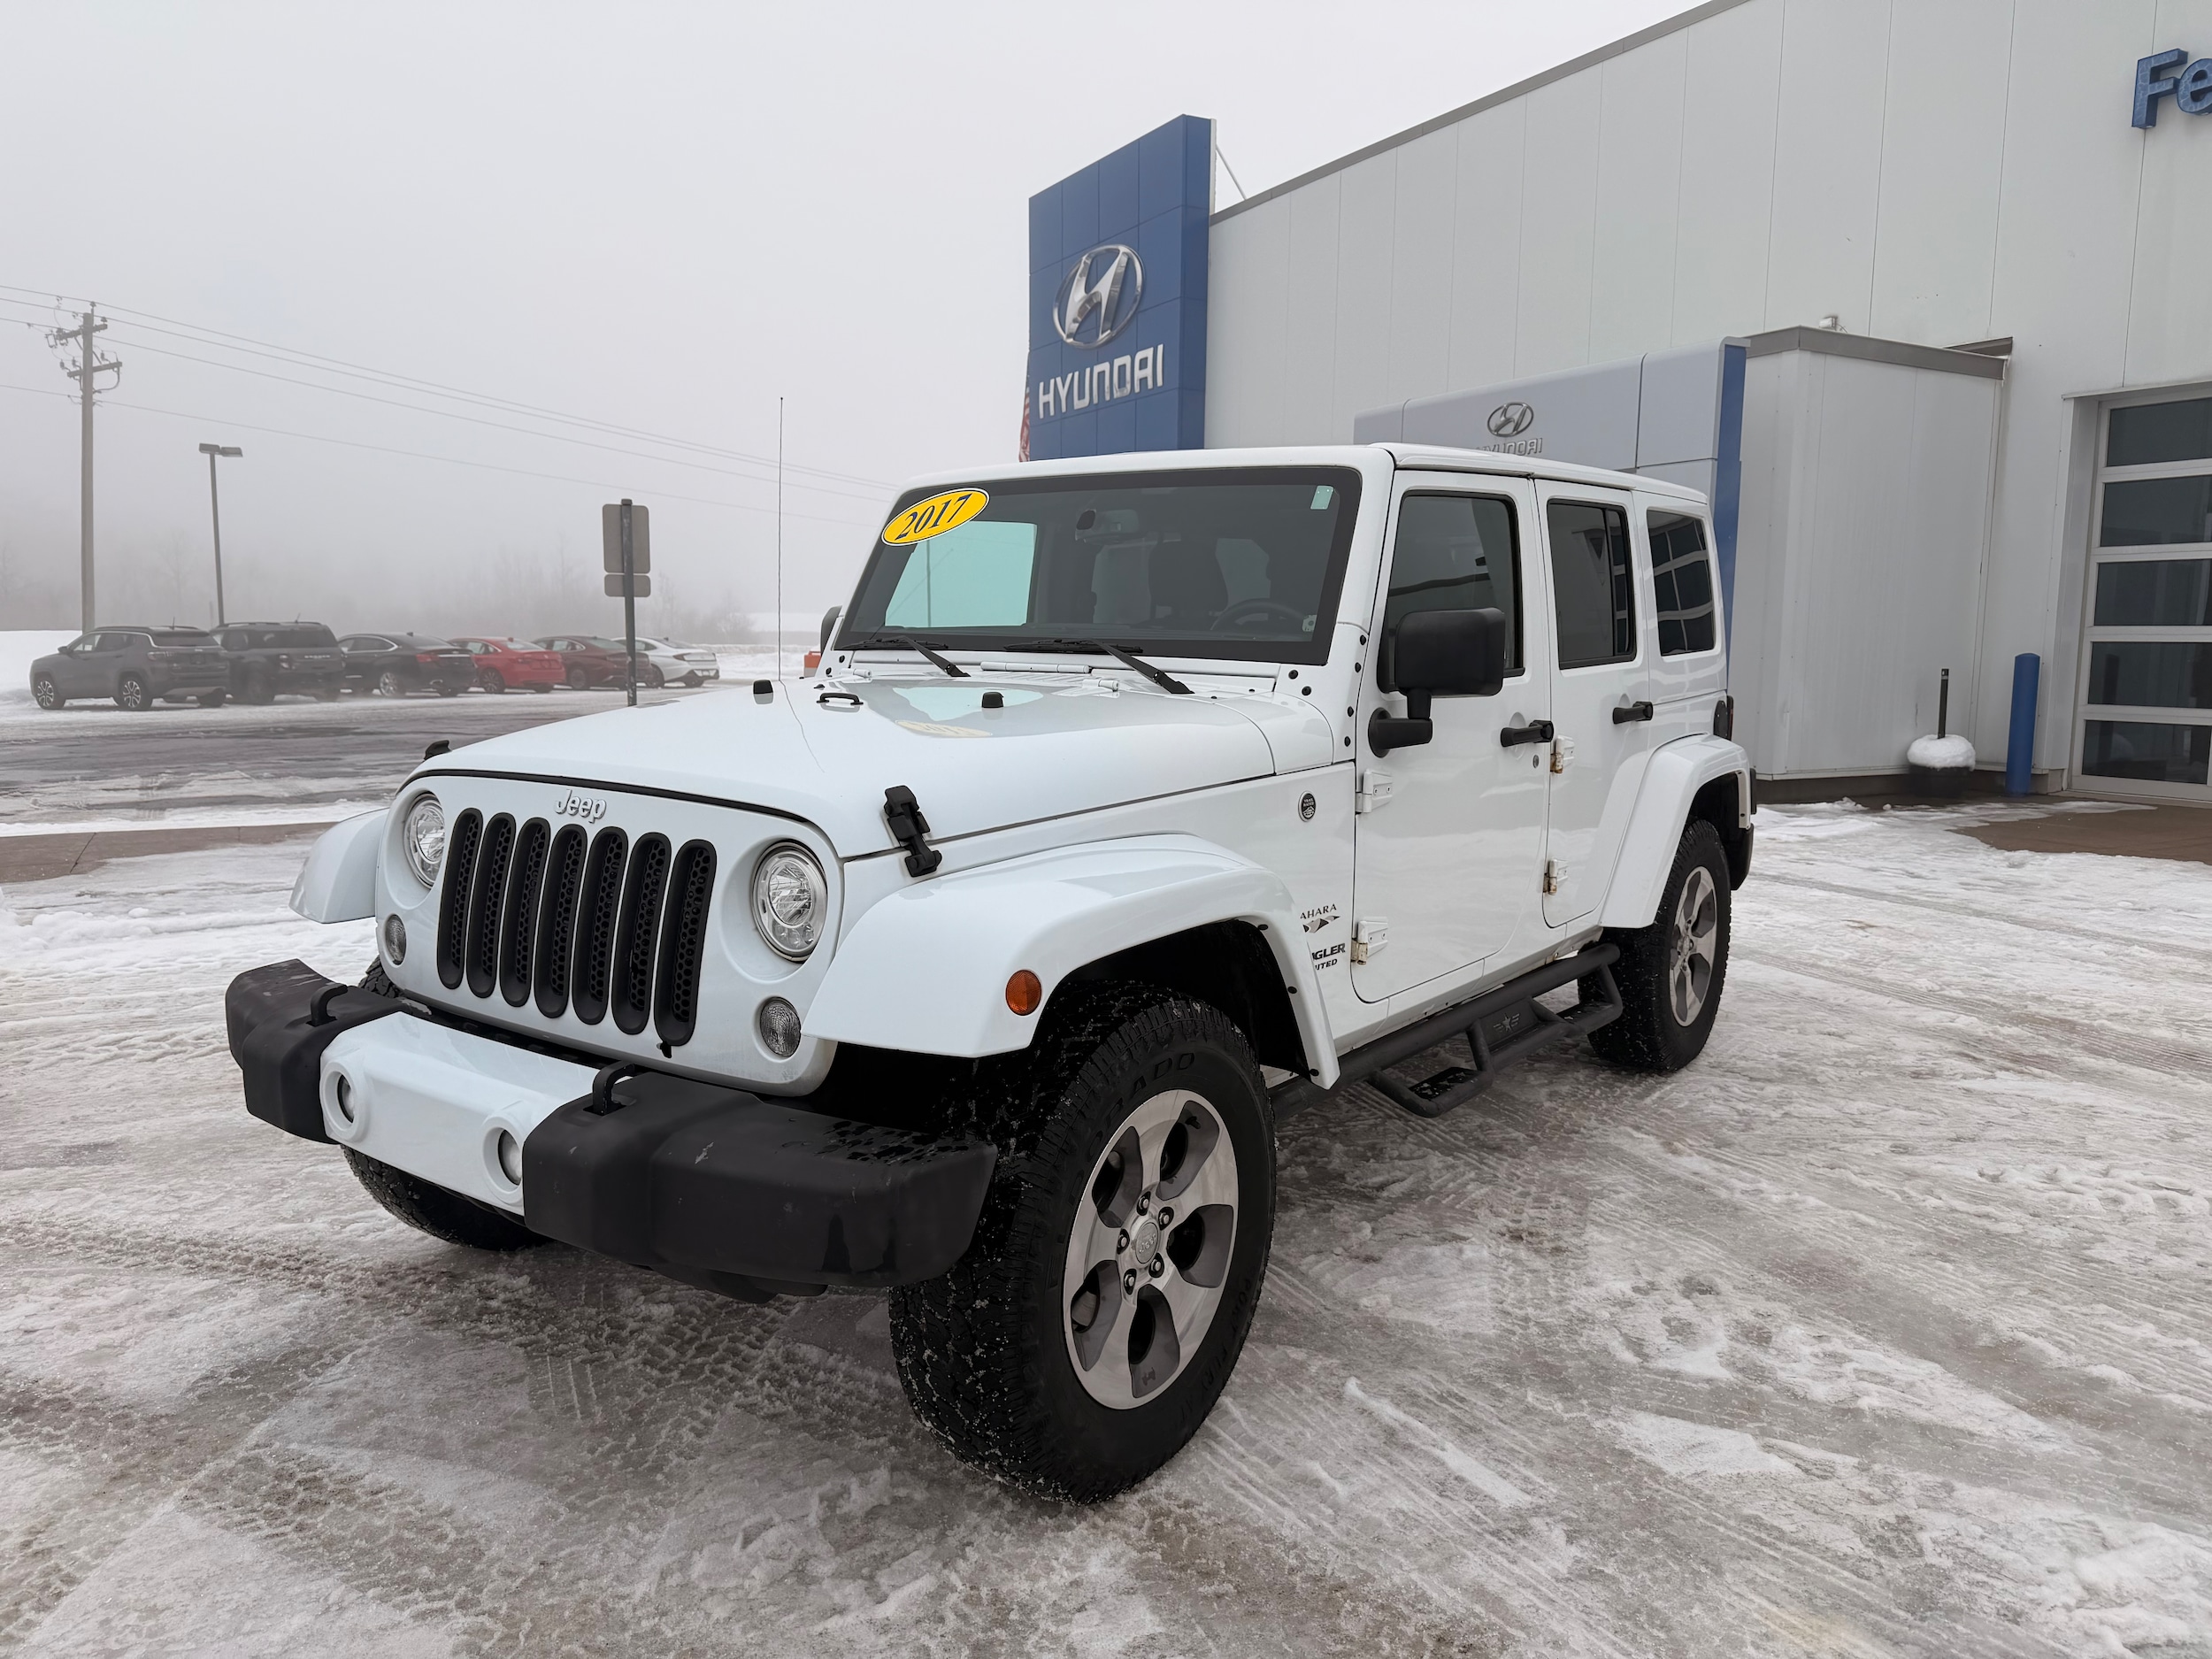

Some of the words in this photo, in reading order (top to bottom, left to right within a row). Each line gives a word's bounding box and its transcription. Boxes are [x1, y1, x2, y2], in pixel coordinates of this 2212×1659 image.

[2131, 48, 2212, 130] Fe
[1039, 343, 1164, 419] HYUNDAI
[1476, 437, 1543, 457] UNDAI
[894, 492, 973, 541] 2017
[554, 788, 607, 825] Jeep
[1300, 903, 1337, 919] AHARA
[1311, 942, 1346, 961] GLER
